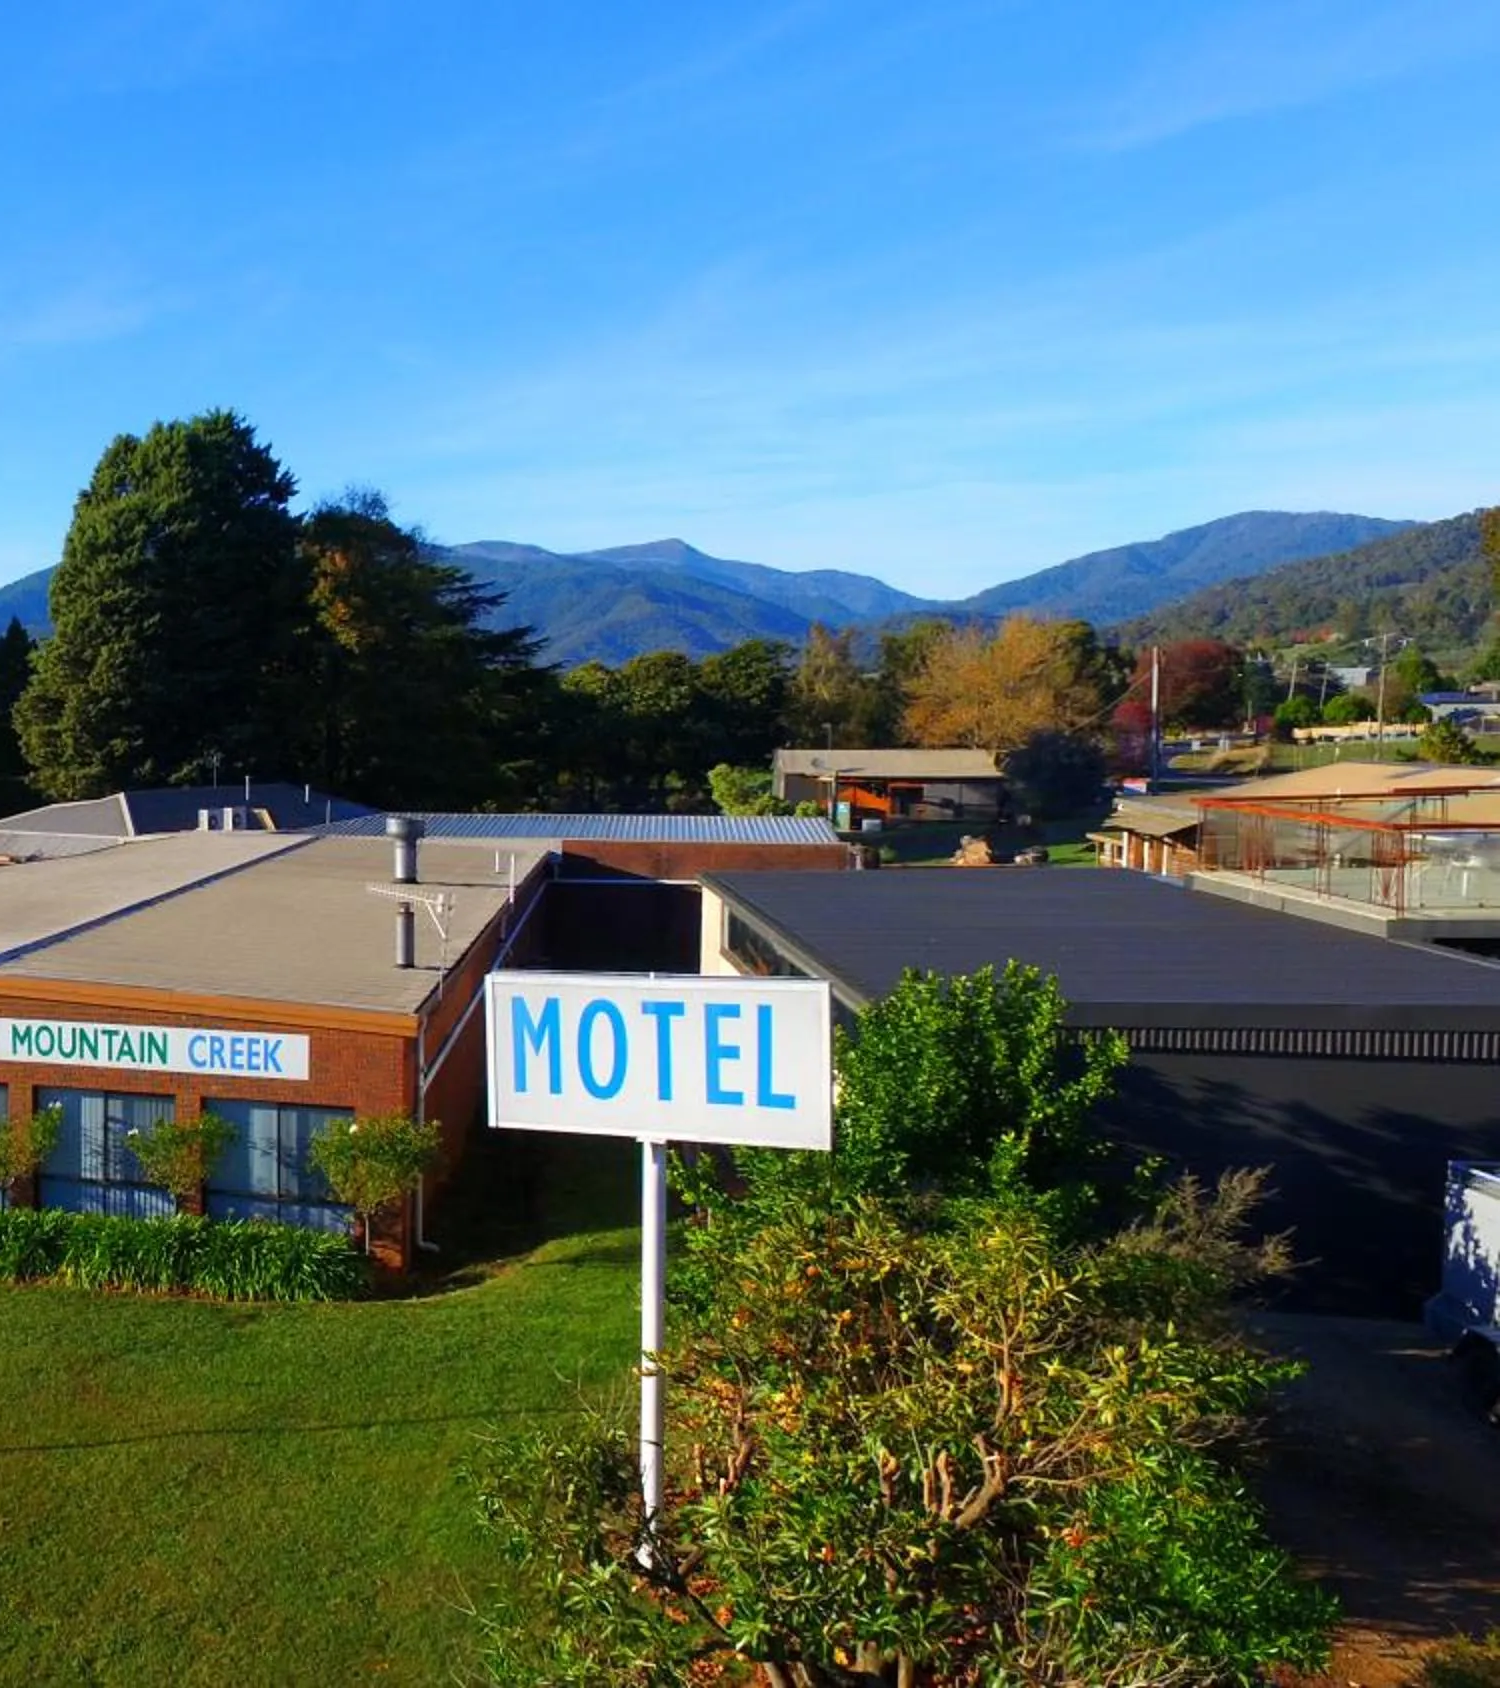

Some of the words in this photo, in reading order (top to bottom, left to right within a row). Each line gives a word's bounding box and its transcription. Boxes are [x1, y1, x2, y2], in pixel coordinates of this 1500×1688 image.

[12, 1024, 167, 1064] MOUNTAIN
[187, 1034, 283, 1072] CREEK
[511, 996, 796, 1109] MOTEL
